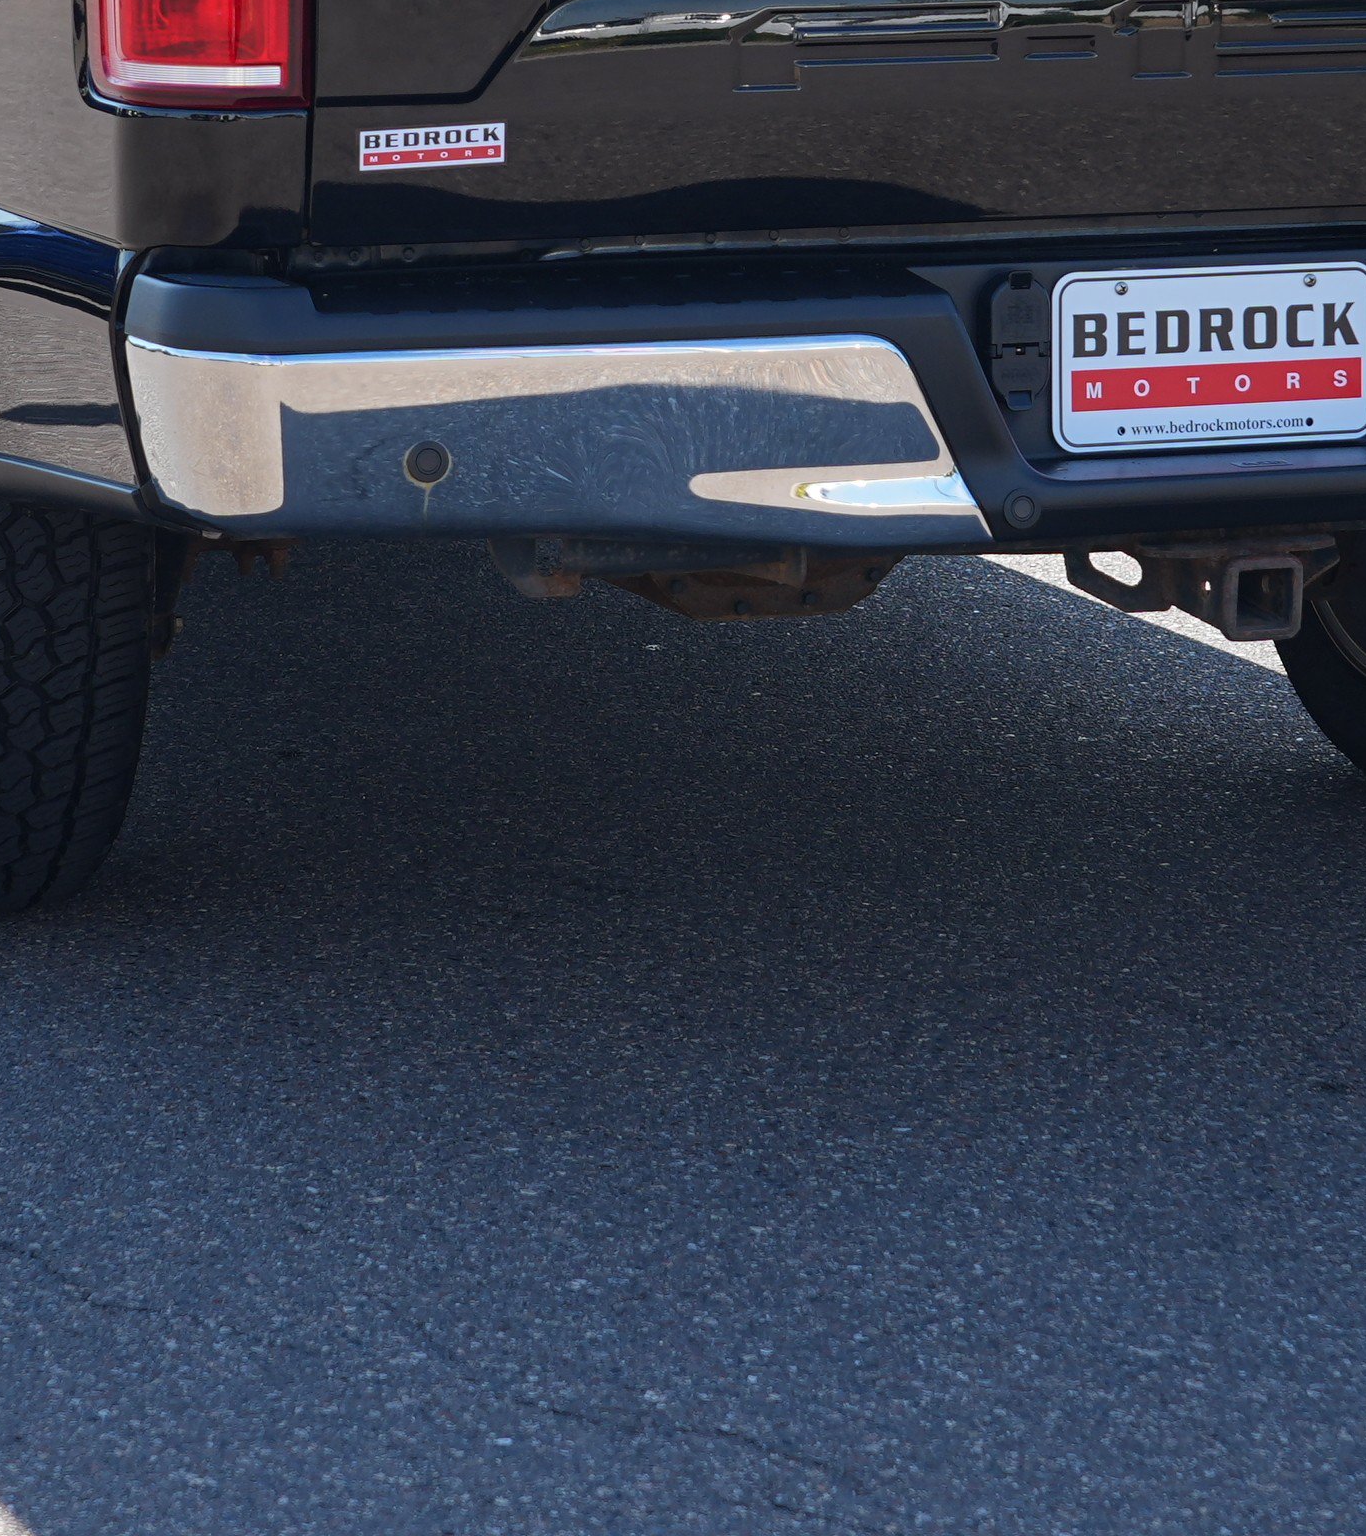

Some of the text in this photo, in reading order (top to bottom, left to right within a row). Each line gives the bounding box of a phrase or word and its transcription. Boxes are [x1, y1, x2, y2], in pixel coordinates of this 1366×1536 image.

[364, 127, 501, 150] BEDROCK
[369, 148, 495, 163] MOTORS
[1072, 302, 1360, 358] BEDROCK
[1085, 369, 1349, 400] MOTORS
[1130, 416, 1305, 437] www.bedrockmotors.com
